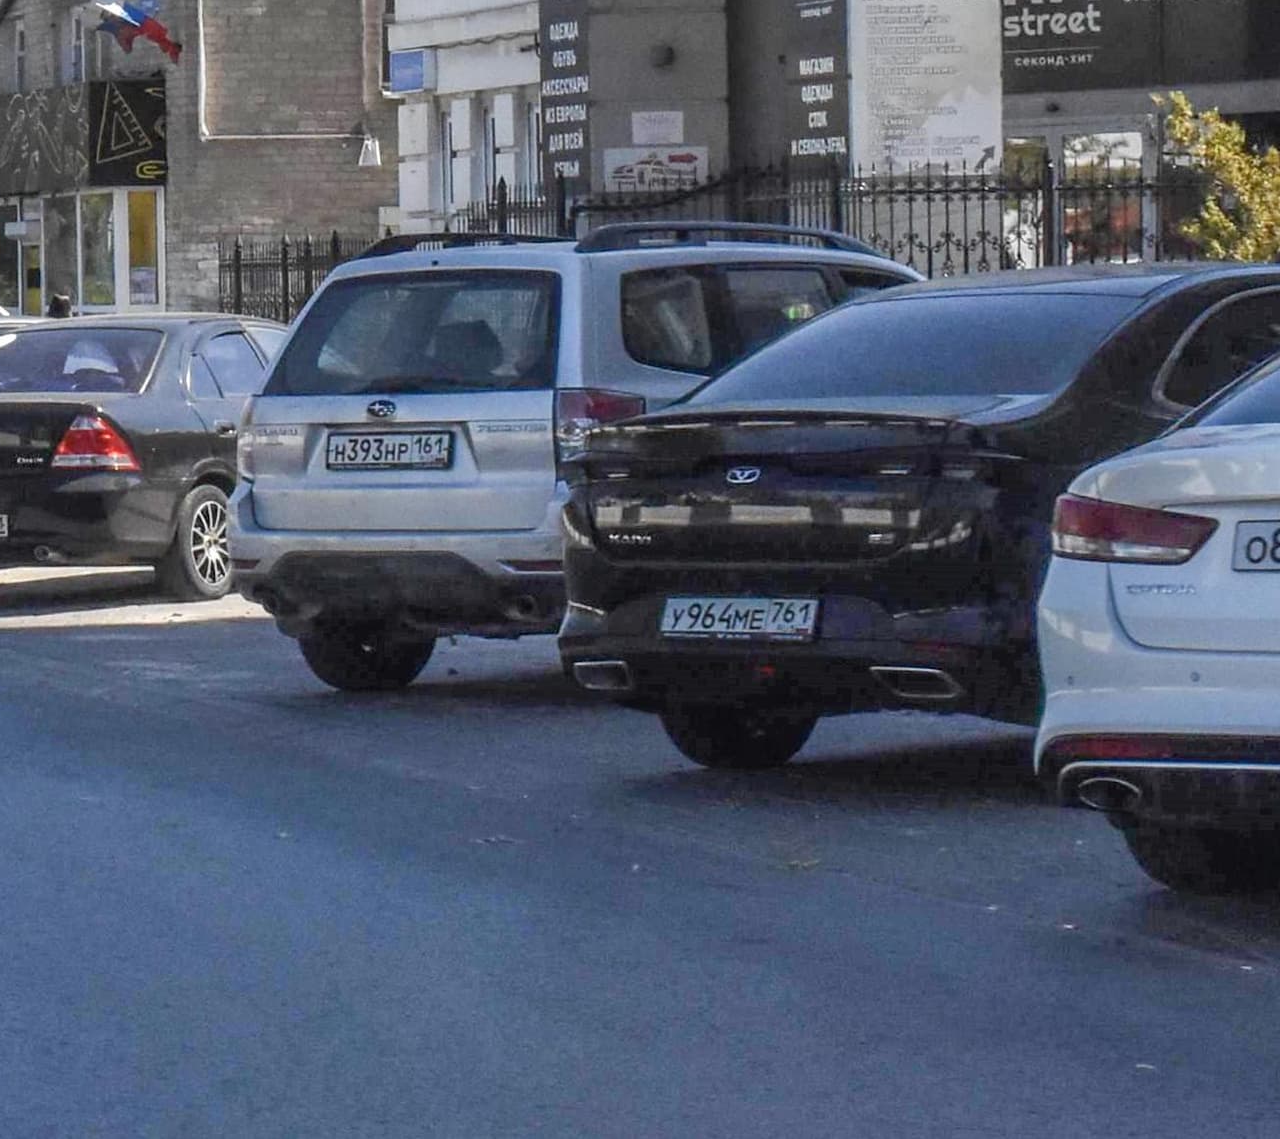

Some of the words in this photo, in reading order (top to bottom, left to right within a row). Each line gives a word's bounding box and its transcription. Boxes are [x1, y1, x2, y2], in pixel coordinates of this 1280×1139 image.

[1003, 3, 1102, 38] street
[549, 21, 579, 41] ОДЕЖДА
[799, 56, 834, 76] МАГАЗИН
[1014, 52, 1094, 68] секонд-хит
[541, 75, 589, 96] АКСЕССУАРЫ
[801, 83, 834, 104] ОДЕЖДЫ
[808, 111, 828, 128] СТОК
[771, 600, 811, 625] 761
